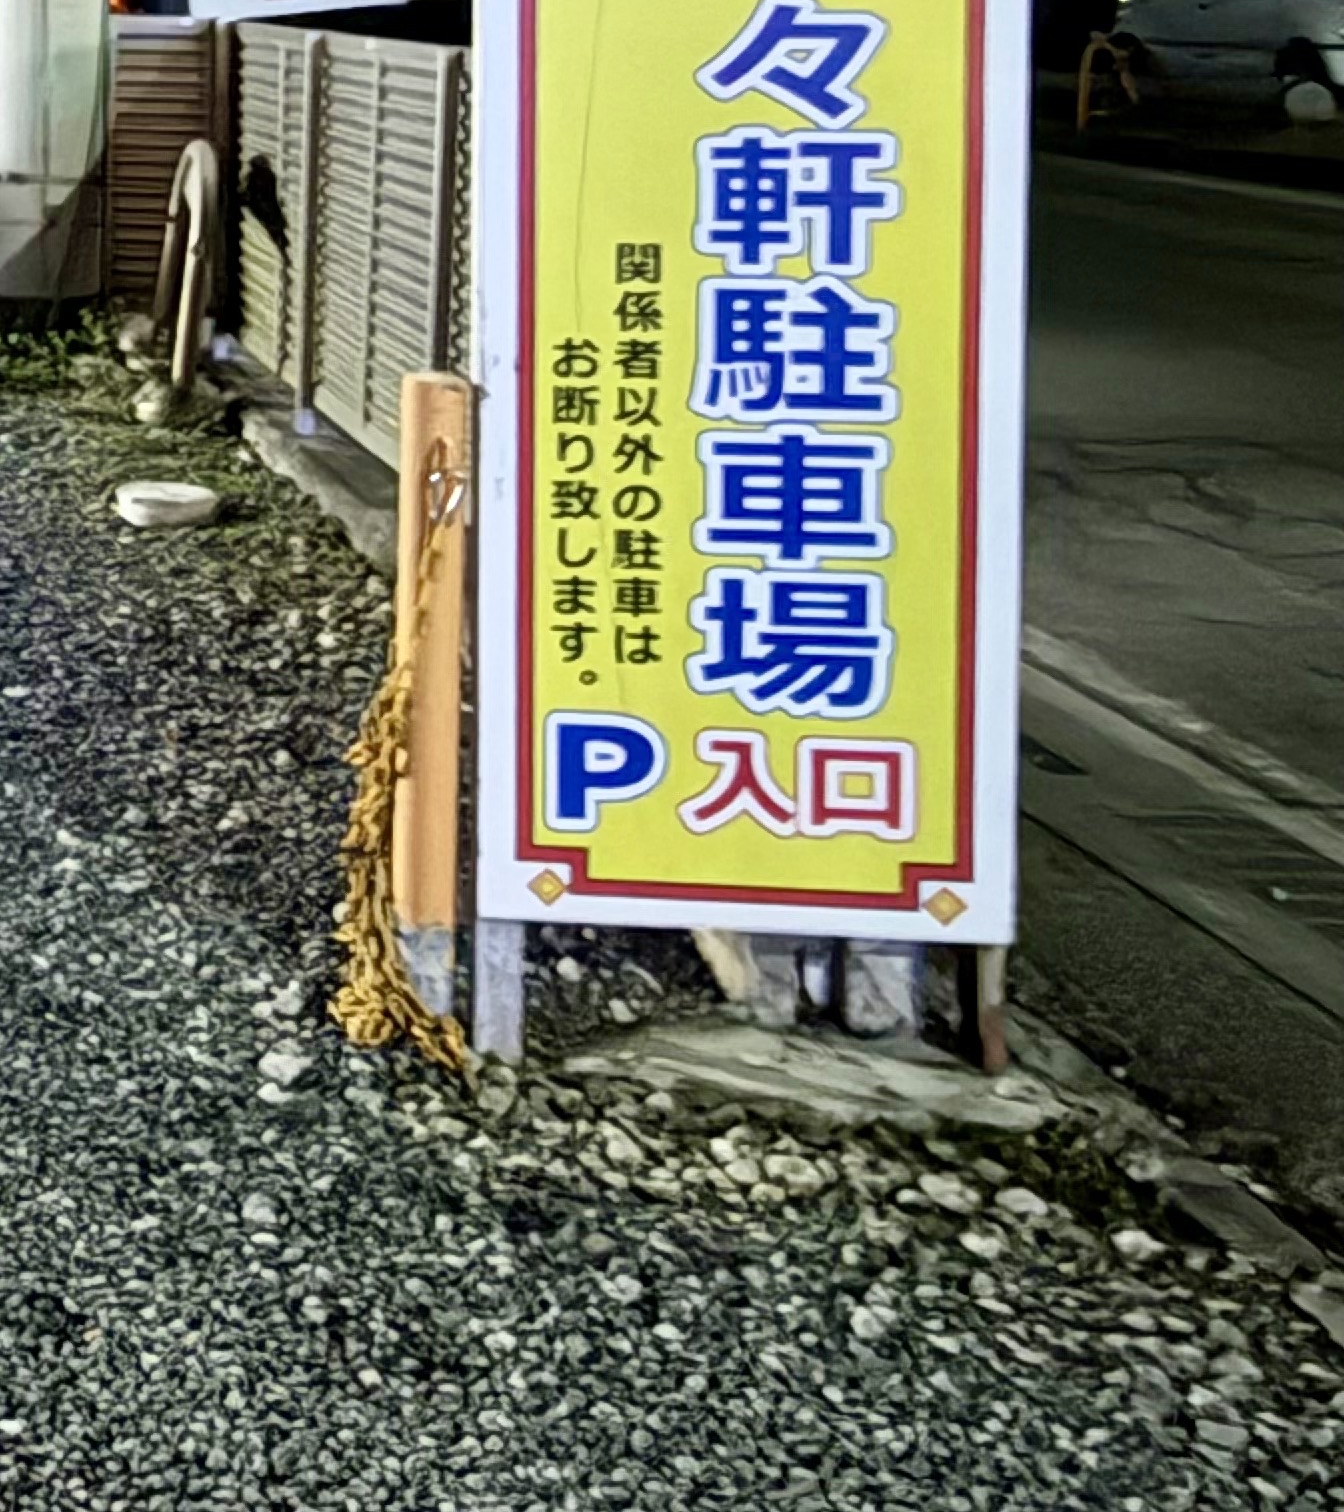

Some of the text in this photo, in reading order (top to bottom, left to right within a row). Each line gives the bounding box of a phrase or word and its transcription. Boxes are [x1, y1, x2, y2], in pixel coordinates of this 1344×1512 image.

[550, 337, 600, 687] お断り致します。
[611, 242, 663, 664] 関係者以外の駐車は
[556, 721, 658, 821] P
[692, 739, 909, 833] 入口
